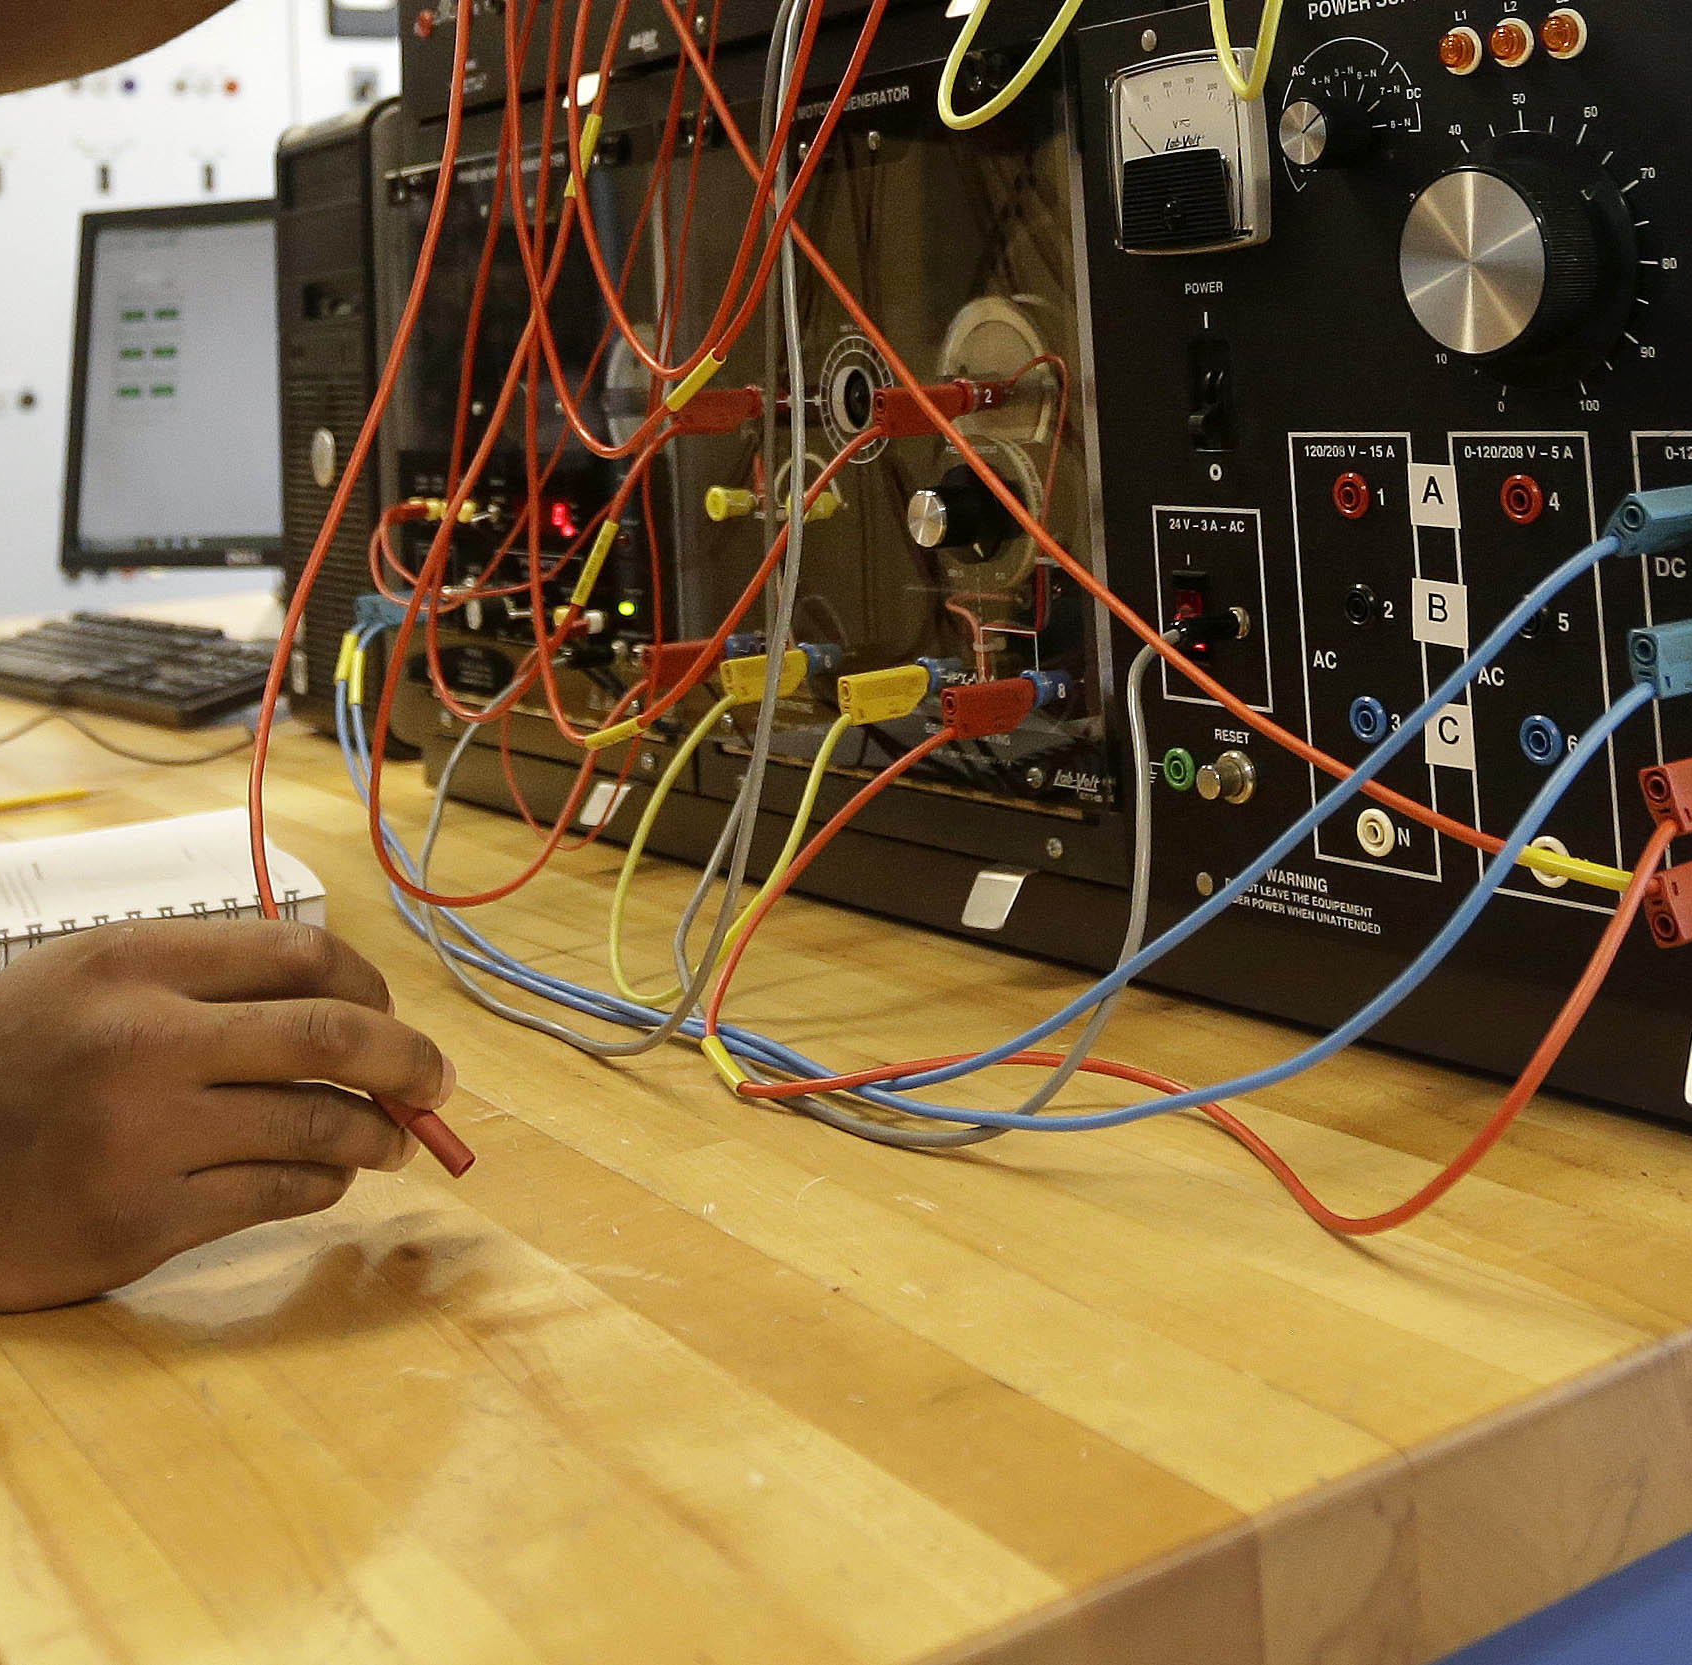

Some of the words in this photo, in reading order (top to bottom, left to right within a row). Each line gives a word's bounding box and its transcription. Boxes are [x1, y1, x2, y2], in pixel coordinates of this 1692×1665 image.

[1503, 1, 1518, 13] L2
[1454, 9, 1468, 22] L1
[1291, 65, 1306, 77] AC
[1406, 88, 1422, 100] DC
[1512, 93, 1526, 105] 50
[1583, 106, 1599, 118] 60
[1448, 123, 1462, 136] 40
[1639, 167, 1656, 180] 70
[1661, 257, 1678, 270] 80
[1184, 281, 1224, 295] POWER
[1435, 352, 1448, 365] 10
[1639, 346, 1656, 358] 90
[984, 388, 993, 403] 2
[1497, 400, 1505, 413] 0
[1579, 399, 1600, 412] 100
[1304, 445, 1345, 458] 120/208
[1347, 445, 1356, 458] V
[1369, 445, 1383, 458] 15
[1386, 445, 1395, 458] A
[1464, 445, 1524, 459] 0-120/208
[1526, 445, 1536, 459] V
[1551, 445, 1559, 459] 5
[1563, 446, 1573, 460] A
[1377, 488, 1384, 506] 1
[1421, 475, 1444, 505] A
[1549, 492, 1560, 511] 4
[1168, 518, 1181, 530] 24
[1182, 519, 1191, 530] V
[1201, 519, 1208, 531] 3
[1210, 520, 1218, 532] A
[1229, 520, 1245, 533] AC
[1654, 557, 1687, 578] DC
[1383, 600, 1394, 619] 2
[1428, 592, 1448, 623] B
[1558, 612, 1569, 632] 5
[1312, 649, 1337, 670] AC
[1477, 666, 1505, 686] AC
[1058, 683, 1066, 699] 8
[1391, 713, 1401, 732] 3
[1214, 728, 1250, 744] RESET
[1438, 716, 1459, 745] C
[1397, 827, 1411, 847] N
[1266, 868, 1328, 893] WARNING
[1260, 887, 1290, 900] LEAVE
[1291, 891, 1309, 904] THE
[1311, 895, 1373, 918] EQUIPEMENT
[1252, 898, 1286, 914] POWER
[1286, 904, 1315, 921] WHEN
[1316, 912, 1381, 935] UNATTENDED
